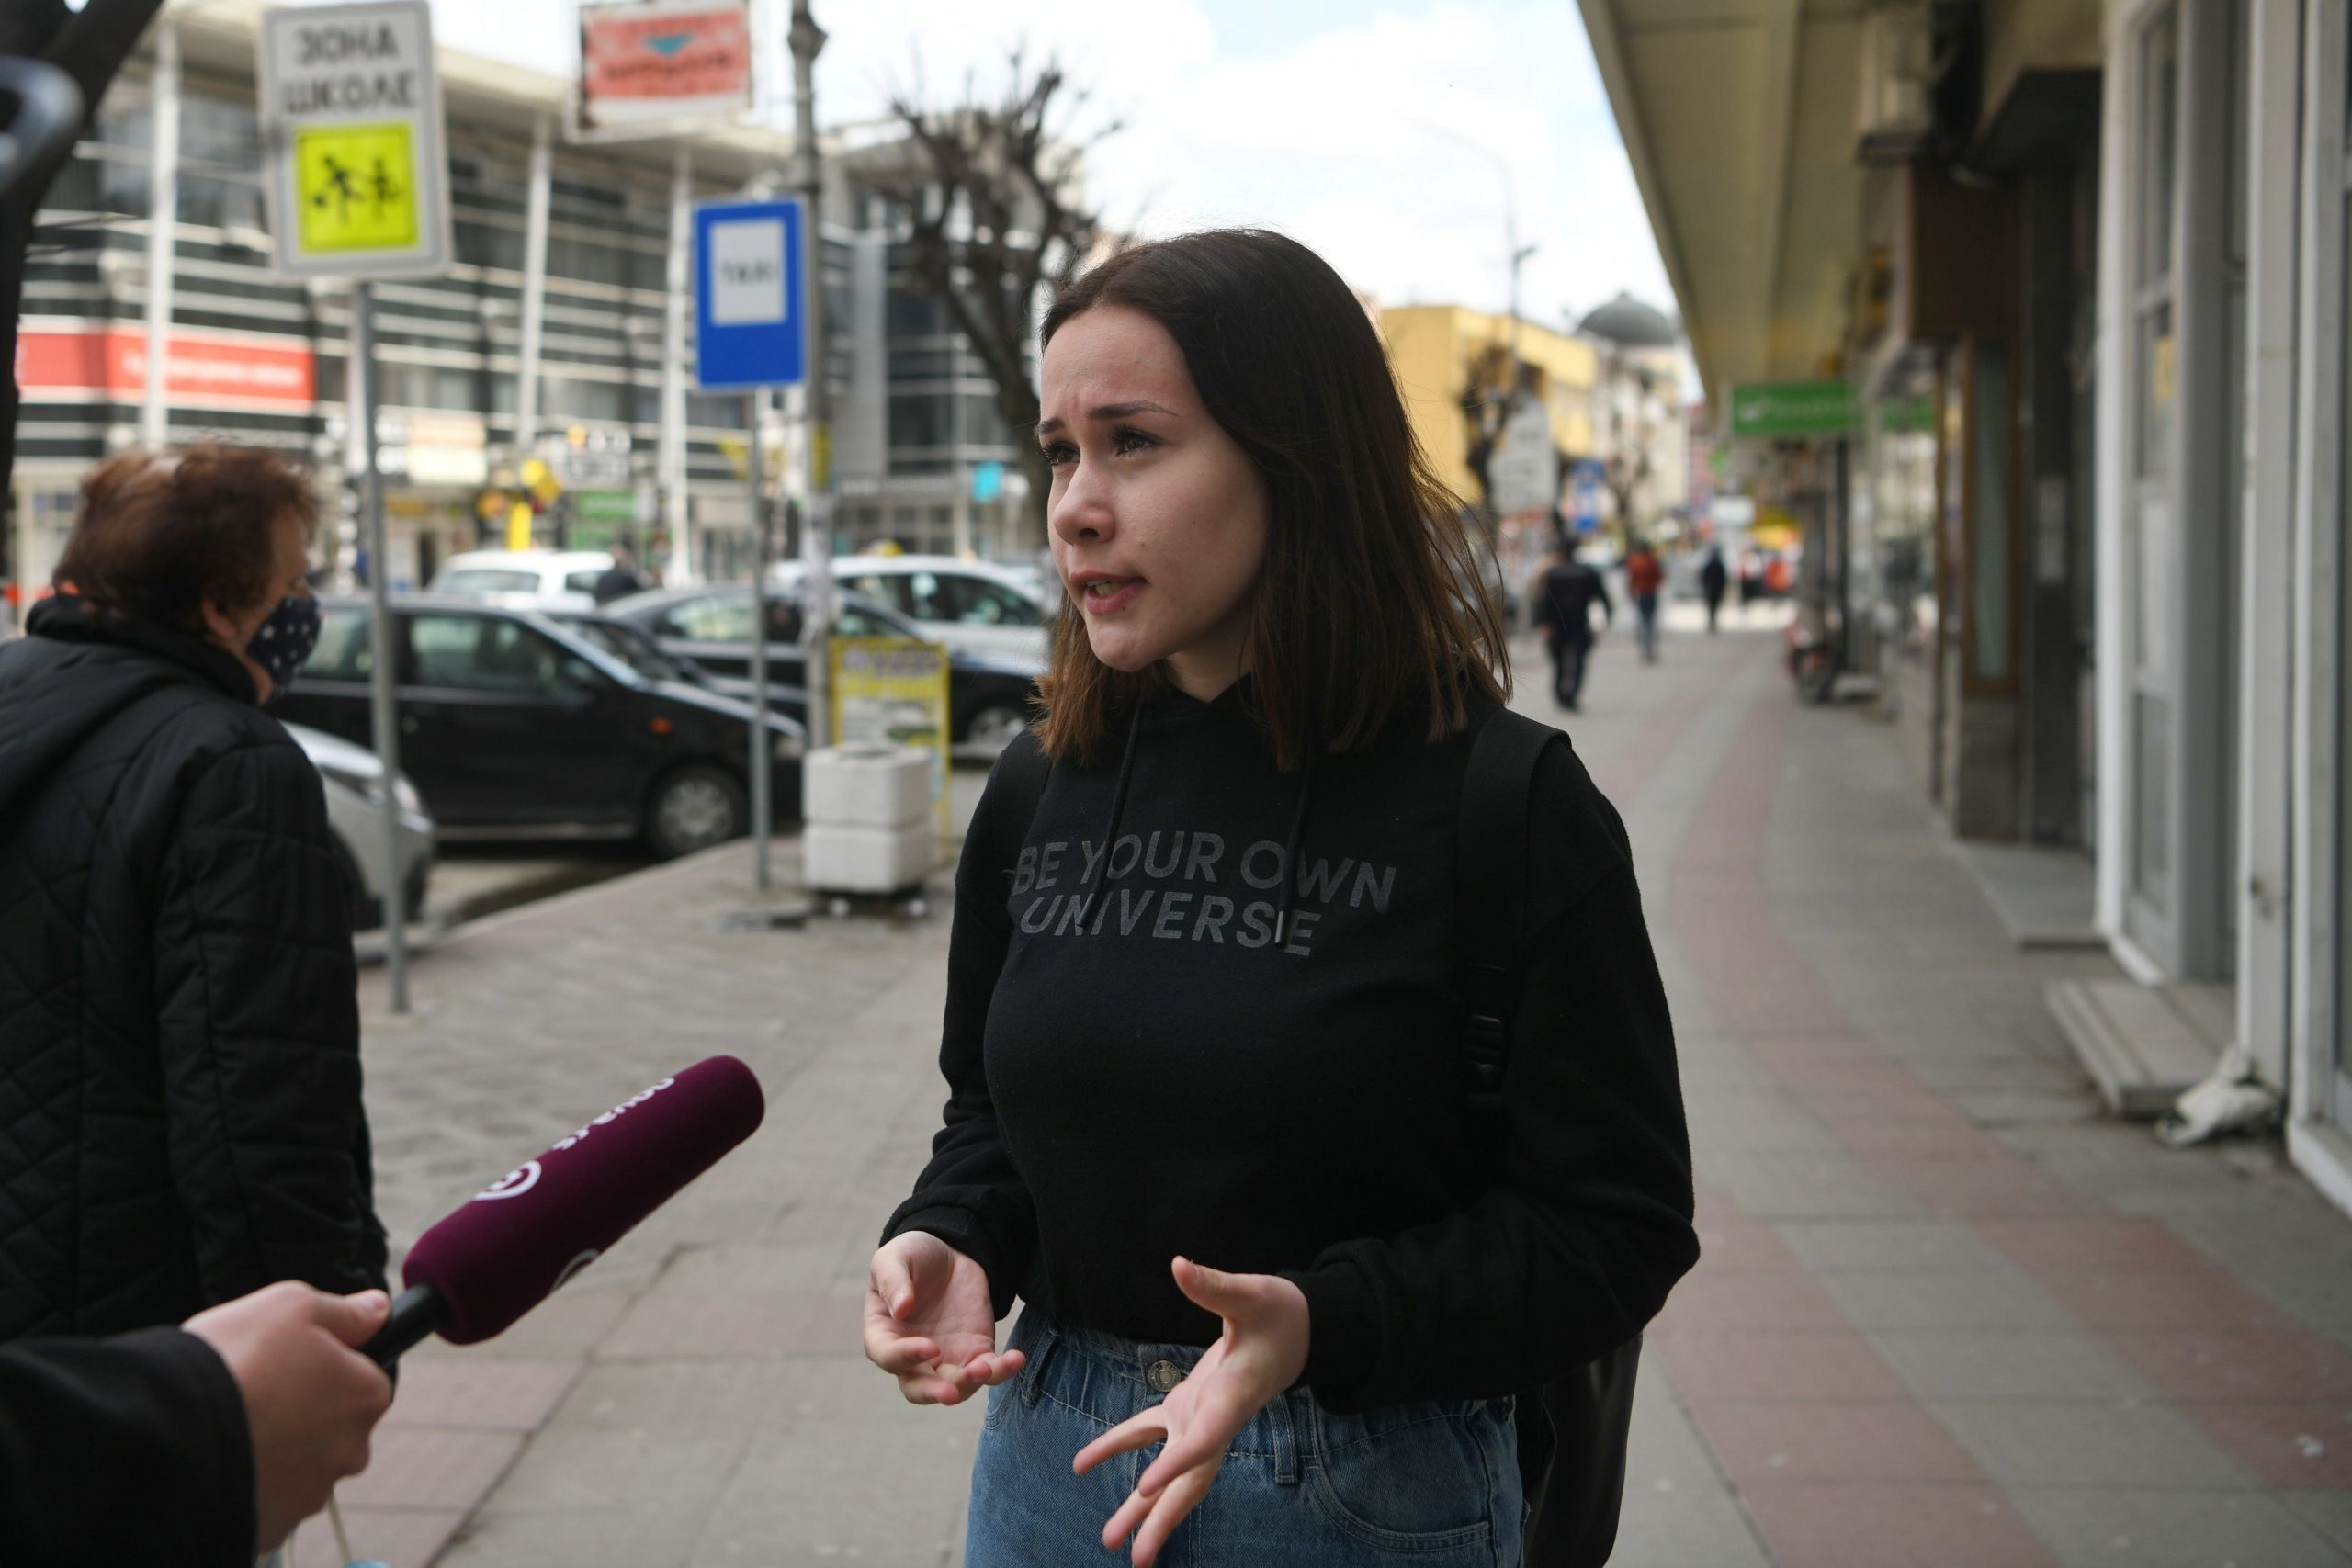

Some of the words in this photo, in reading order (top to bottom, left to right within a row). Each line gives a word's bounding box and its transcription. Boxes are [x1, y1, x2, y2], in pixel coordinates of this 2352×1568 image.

[296, 23, 398, 63] ЗОНА
[283, 72, 414, 113] ШКОЛЕ
[1012, 841, 1067, 897] BE
[1080, 830, 1225, 885] YOUR
[1239, 840, 1396, 913] OWN
[1020, 888, 1322, 956] UNIVERSE
